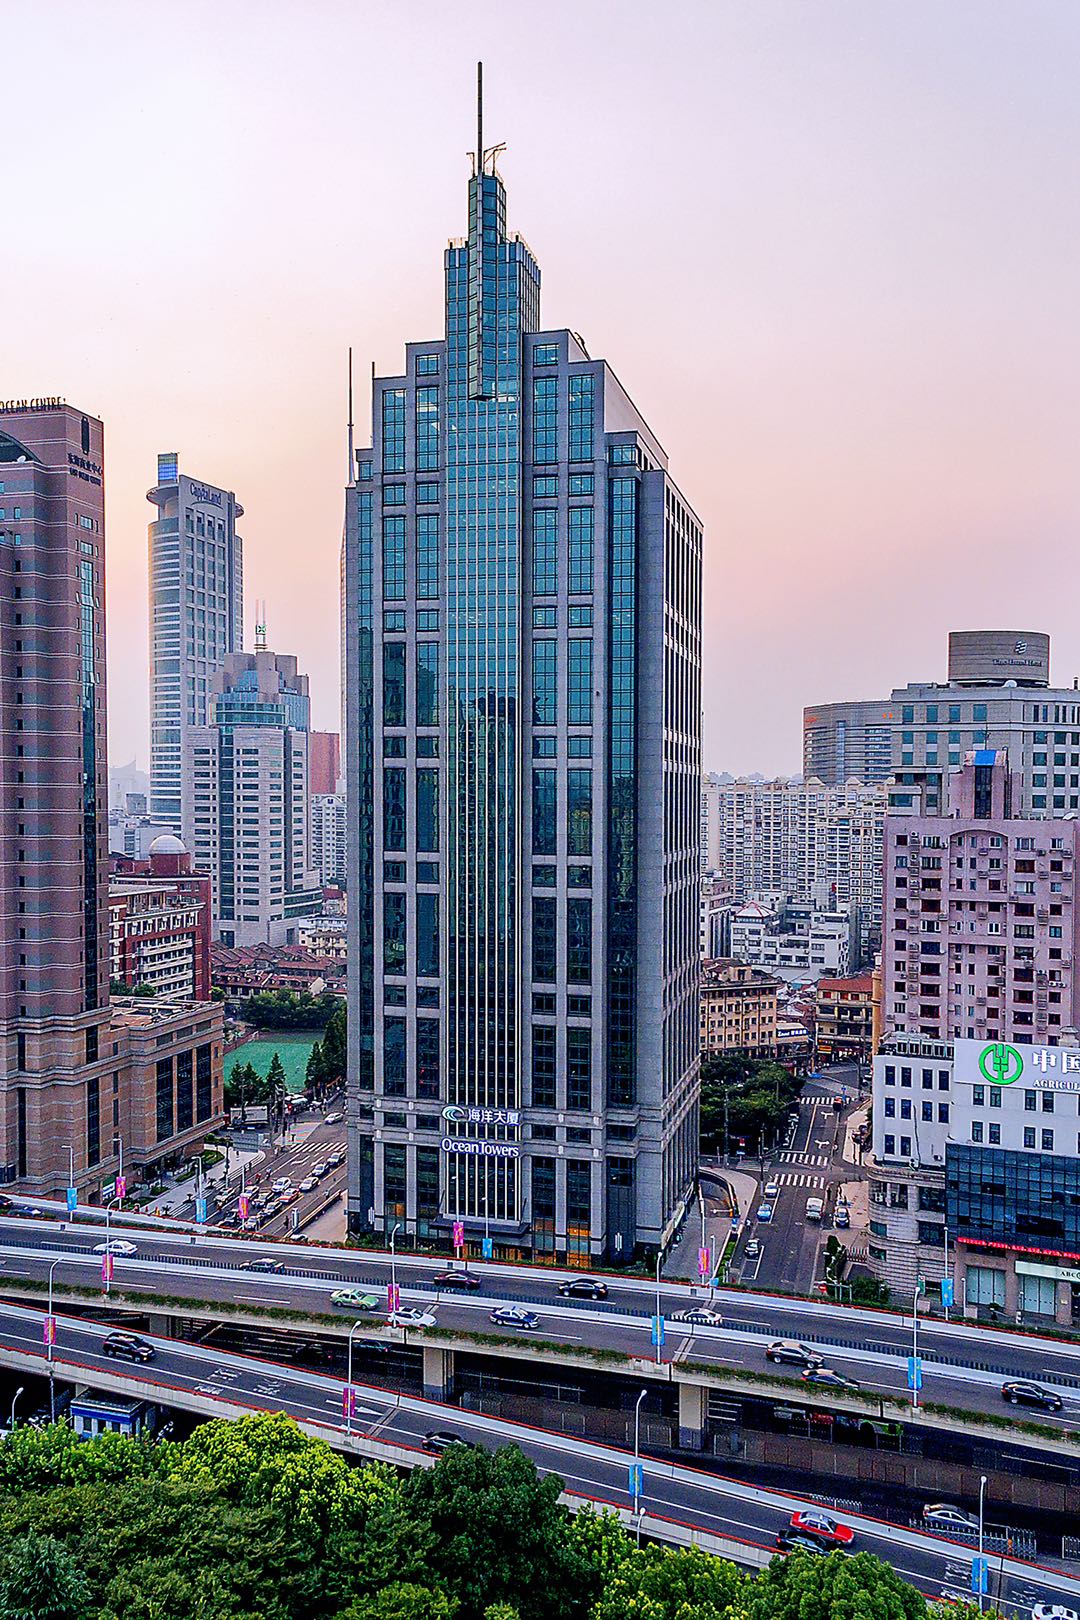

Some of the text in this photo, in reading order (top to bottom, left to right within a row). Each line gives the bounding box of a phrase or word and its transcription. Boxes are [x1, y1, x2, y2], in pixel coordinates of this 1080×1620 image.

[30, 396, 62, 412] CENTRE
[467, 1108, 520, 1125] 海洋大厦
